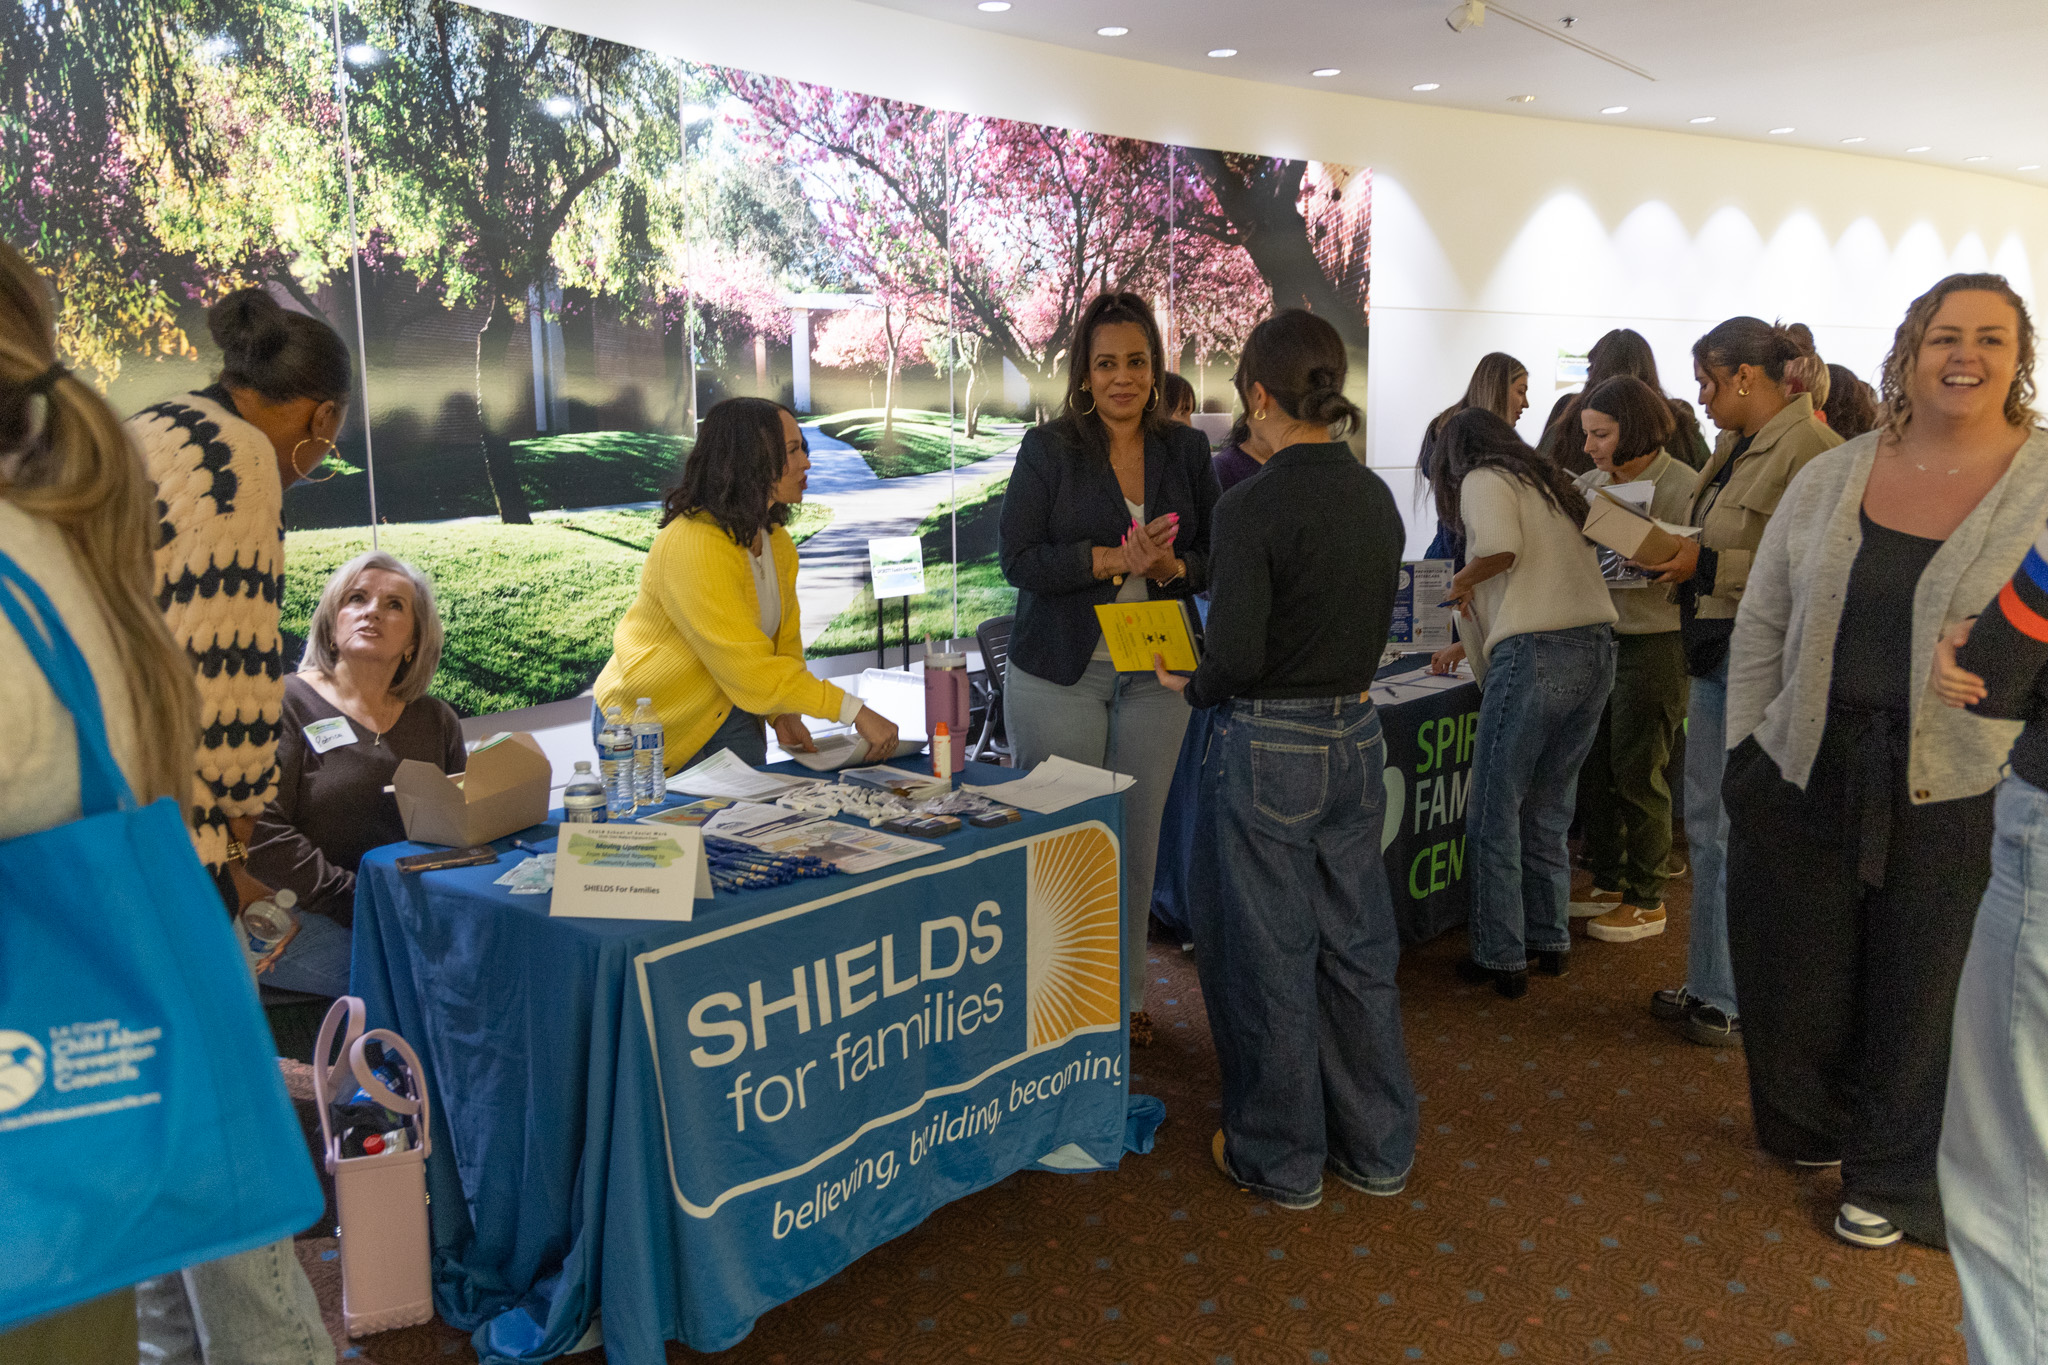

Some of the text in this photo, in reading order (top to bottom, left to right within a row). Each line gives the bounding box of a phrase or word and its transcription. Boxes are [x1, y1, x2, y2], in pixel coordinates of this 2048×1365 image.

[595, 842, 621, 852] Moving
[631, 853, 658, 861] Reporting
[593, 859, 657, 868] Community Supporting
[583, 884, 660, 895] SHIELDS For Families
[687, 900, 1003, 1068] SHIELDS
[727, 982, 1004, 1132] for families
[772, 1150, 900, 1240] believing,
